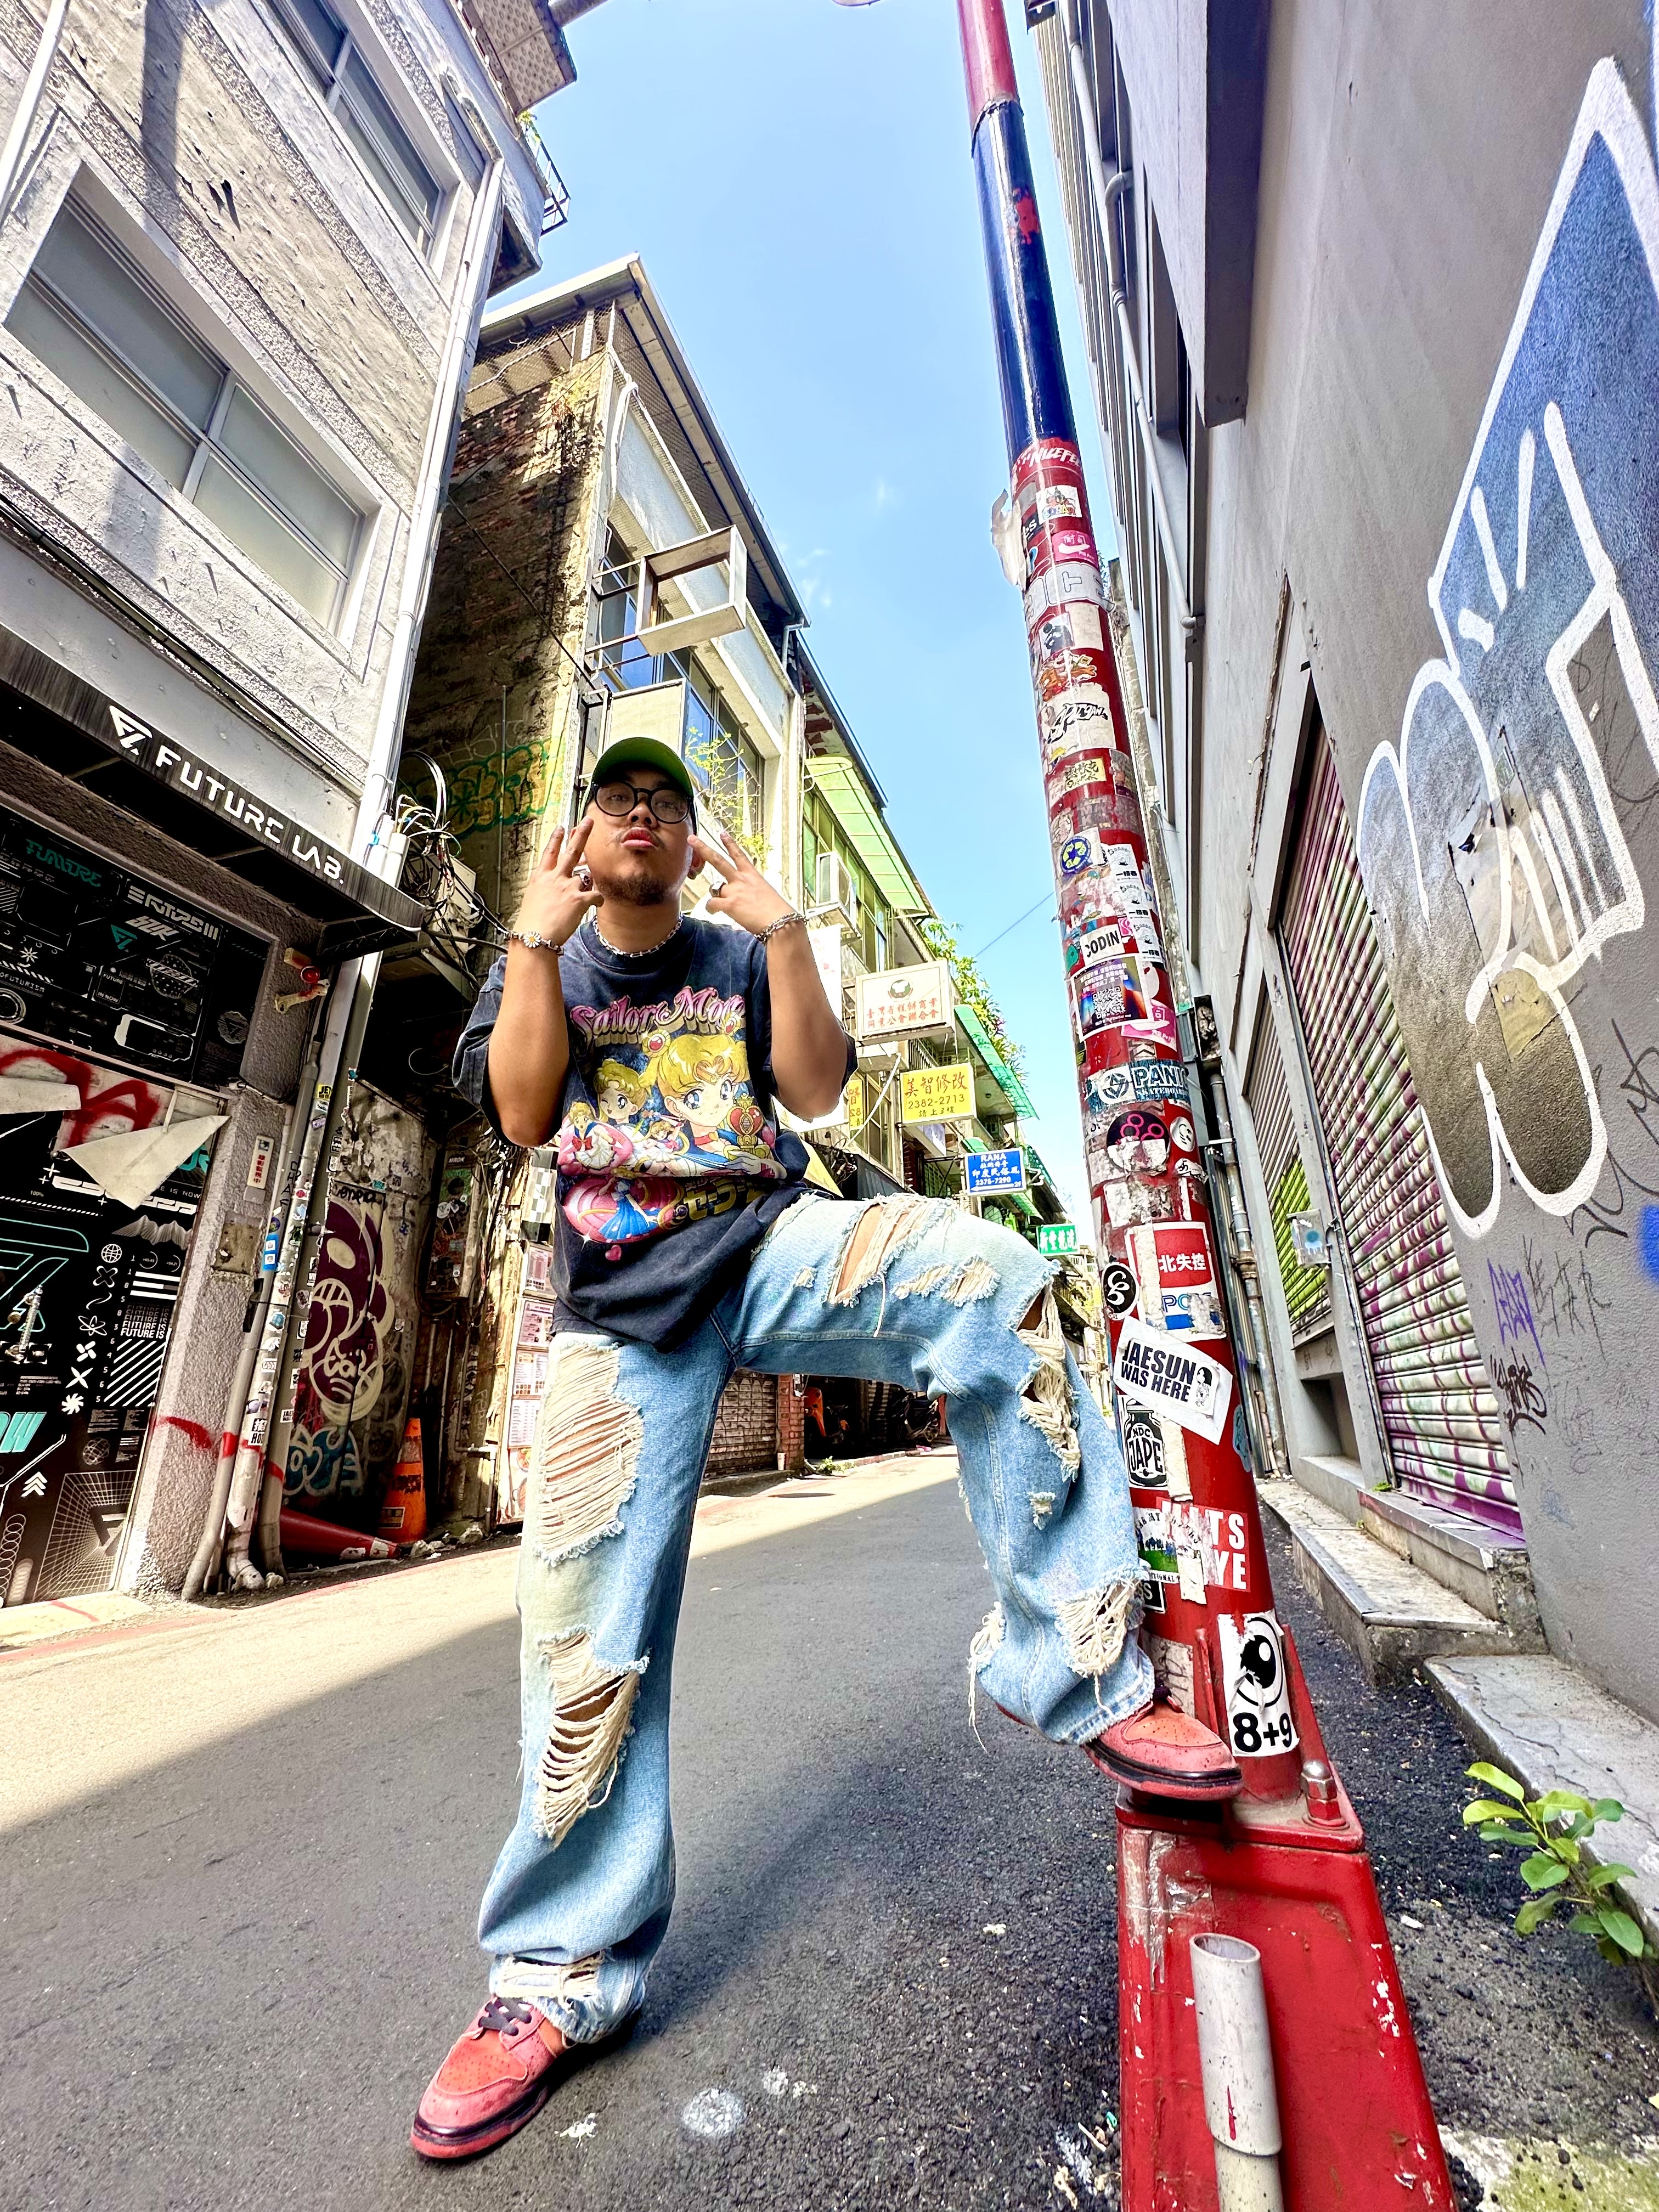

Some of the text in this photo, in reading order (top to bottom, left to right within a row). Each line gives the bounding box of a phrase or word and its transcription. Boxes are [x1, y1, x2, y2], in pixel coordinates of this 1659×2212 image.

[156, 745, 344, 884] FUTURE LAB.
[103, 973, 123, 985] FUTURE
[105, 994, 119, 1003] NOW
[571, 994, 655, 1047] Sailor
[905, 1071, 968, 1098] 美智修改
[908, 1094, 964, 1109] 2382-2713
[980, 1153, 1007, 1163] RANA
[975, 1176, 1012, 1186] 2375-7290
[120, 1328, 165, 1339] FUTURE IS
[1122, 1340, 1197, 1385] JAESUN
[1121, 1362, 1191, 1403] WAS HERE
[1233, 1712, 1292, 1753] 8+9
